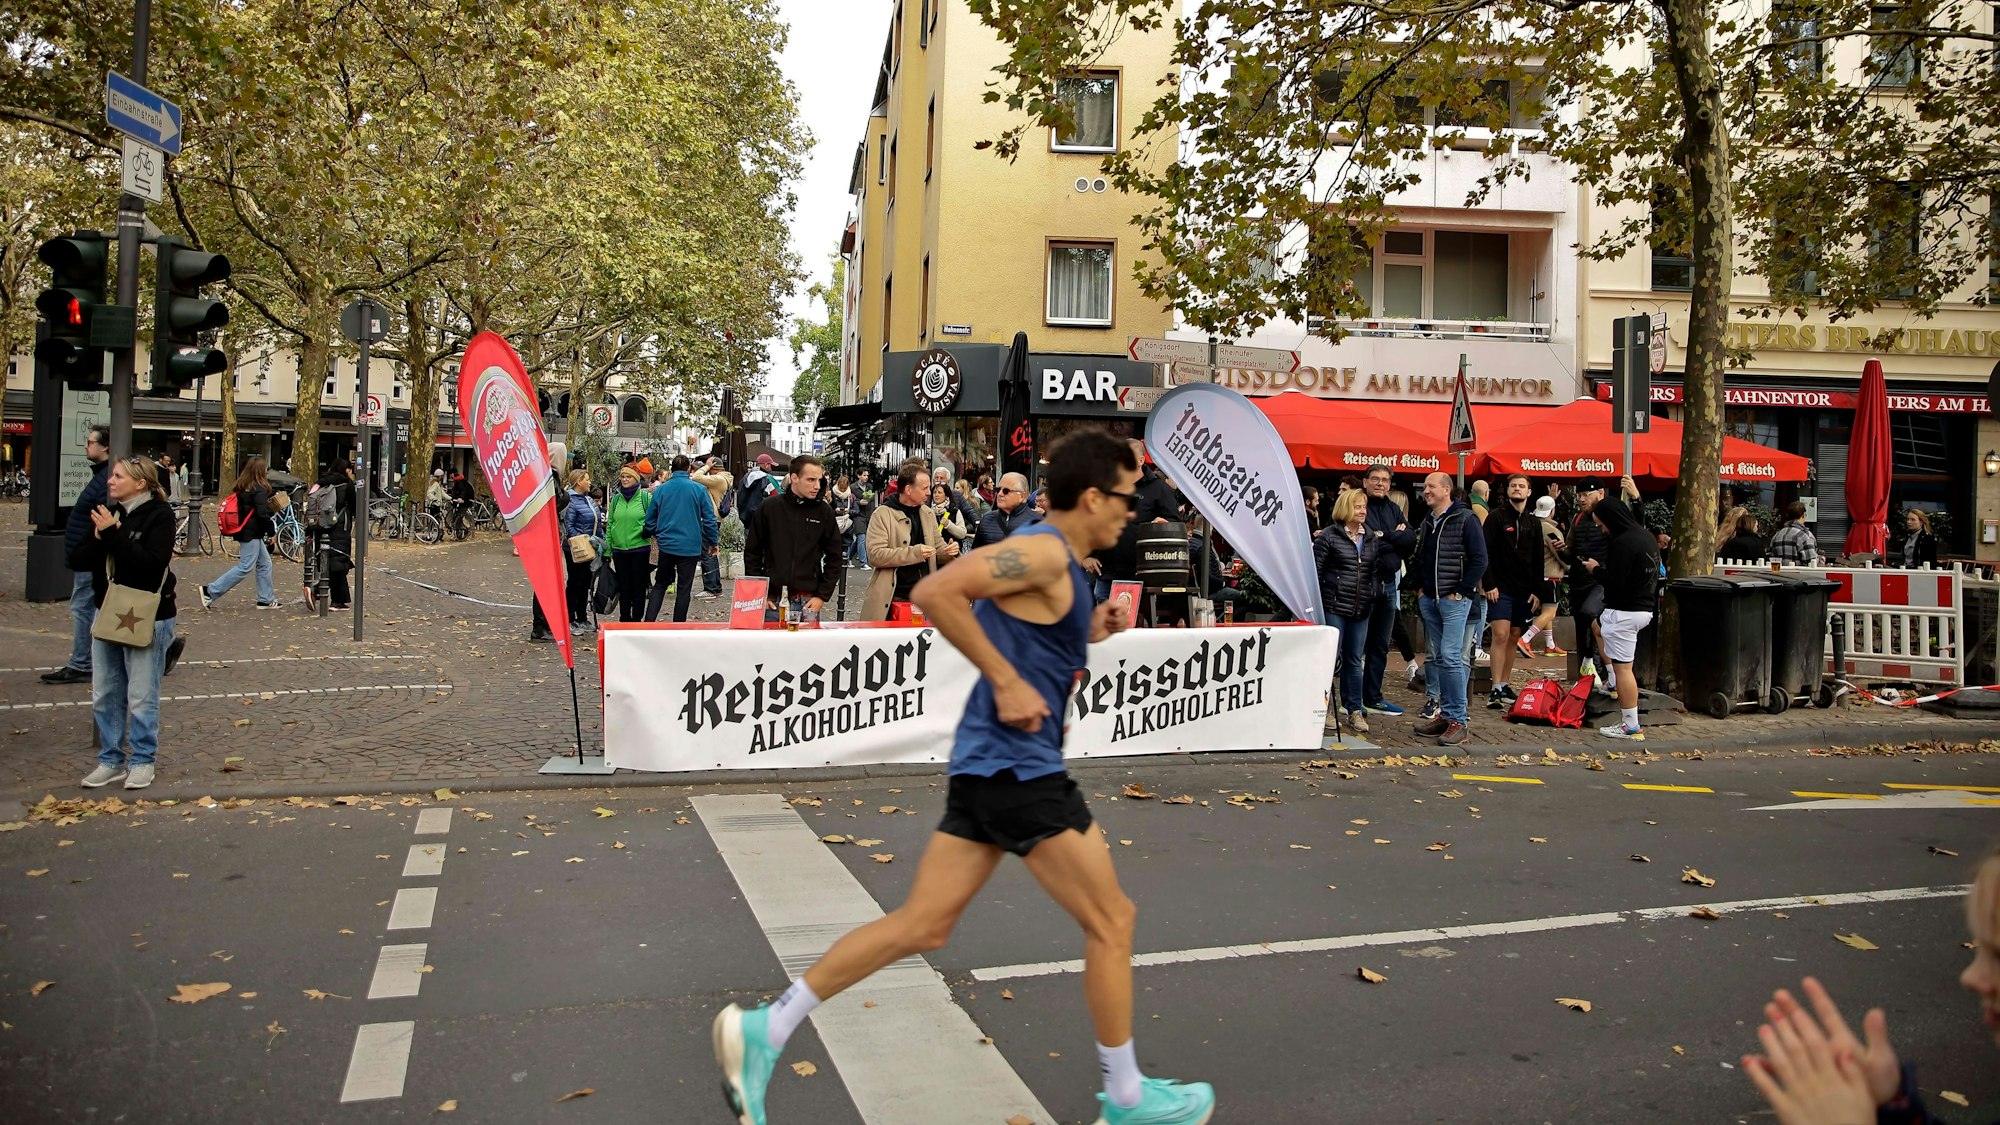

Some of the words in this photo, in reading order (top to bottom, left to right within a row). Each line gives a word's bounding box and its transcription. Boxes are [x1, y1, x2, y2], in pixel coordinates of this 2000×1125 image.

[112, 93, 163, 128] Einbahnstraße
[1144, 341, 1181, 352] Königsdorf
[1219, 347, 1254, 358] Rheinufer
[921, 353, 951, 368] CAFÉ
[1042, 368, 1118, 402] BAR
[1365, 373, 1402, 392] AM
[912, 384, 922, 399] IL
[919, 382, 959, 412] BARISTA
[1724, 390, 1832, 406] HAHNENTOR
[1936, 397, 1966, 411] AM
[1343, 451, 1398, 467] Reissdorf
[1400, 453, 1440, 471] Kölsch
[1521, 458, 1573, 472] Reissdorf
[1575, 457, 1615, 474] Kölsch
[1737, 461, 1776, 478] Kölsch
[1144, 551, 1178, 561] Reissdorf
[677, 628, 934, 735] Reissdorf
[1111, 677, 1264, 743] ALKOHOLFREI
[748, 686, 925, 755] ALKOHOLFREI
